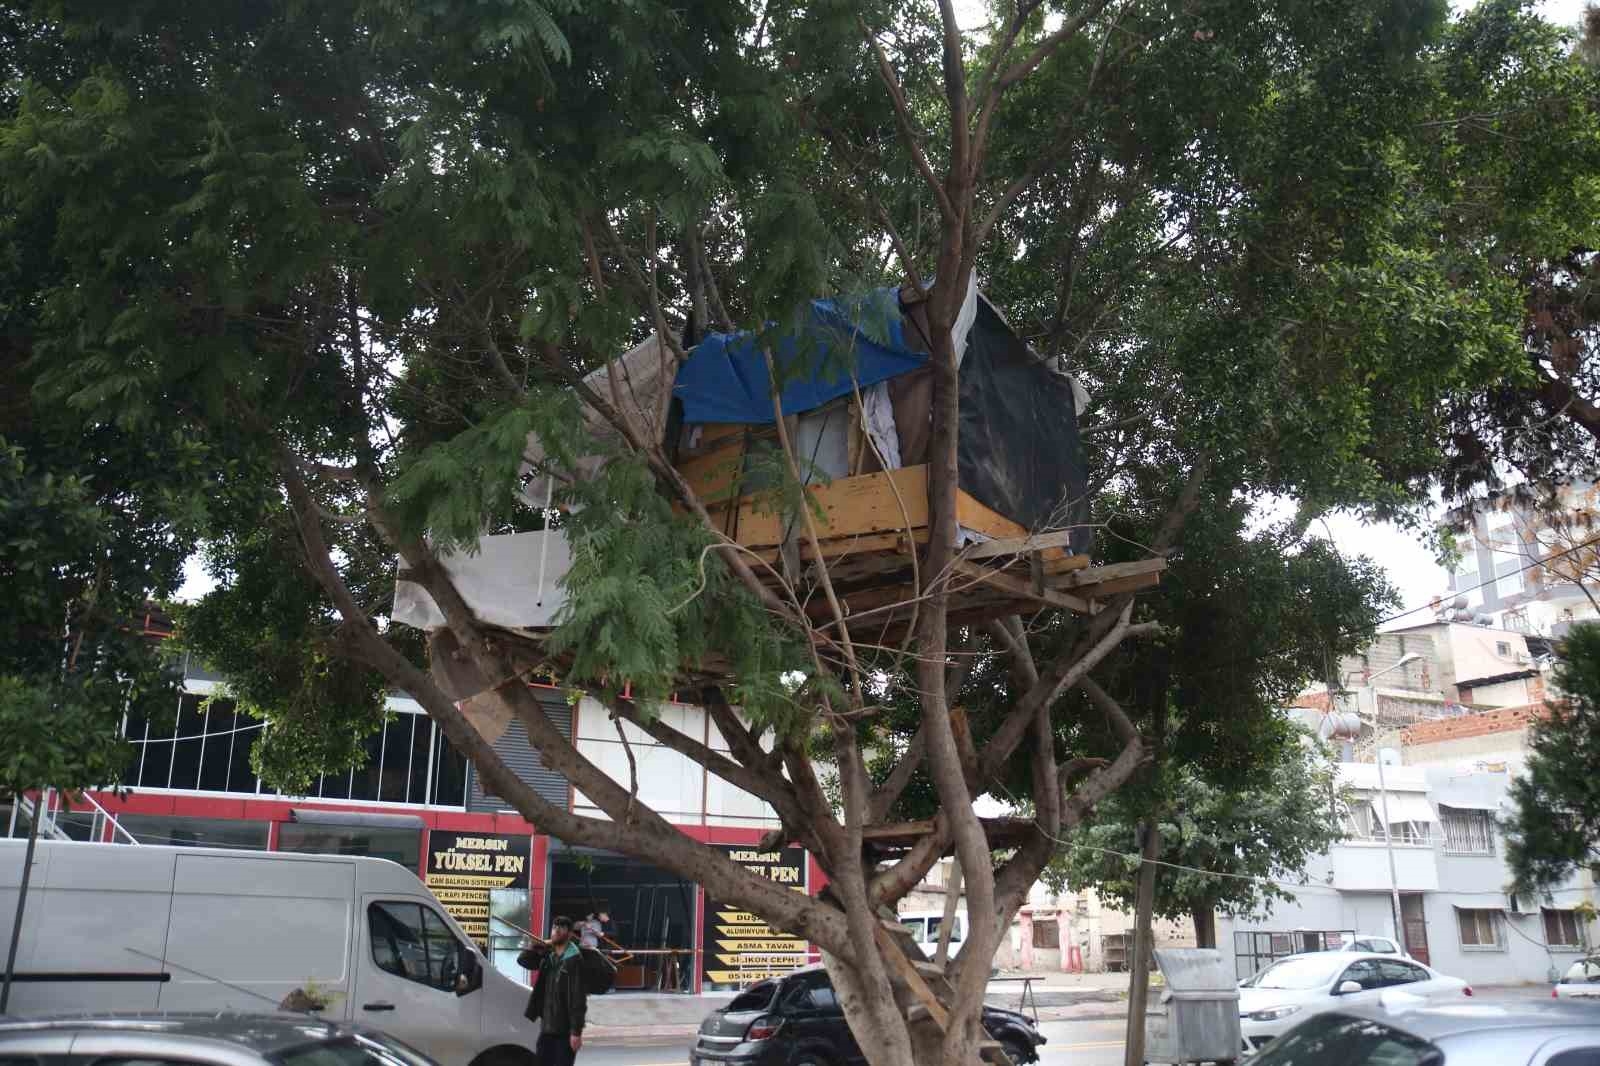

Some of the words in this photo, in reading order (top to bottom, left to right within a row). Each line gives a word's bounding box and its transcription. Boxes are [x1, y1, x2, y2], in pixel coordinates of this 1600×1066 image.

[434, 848, 492, 872] YÜKSEL
[494, 855, 525, 872] PEN
[430, 877, 444, 885] CAM
[445, 877, 469, 885] BALKON
[770, 867, 800, 882] PEN
